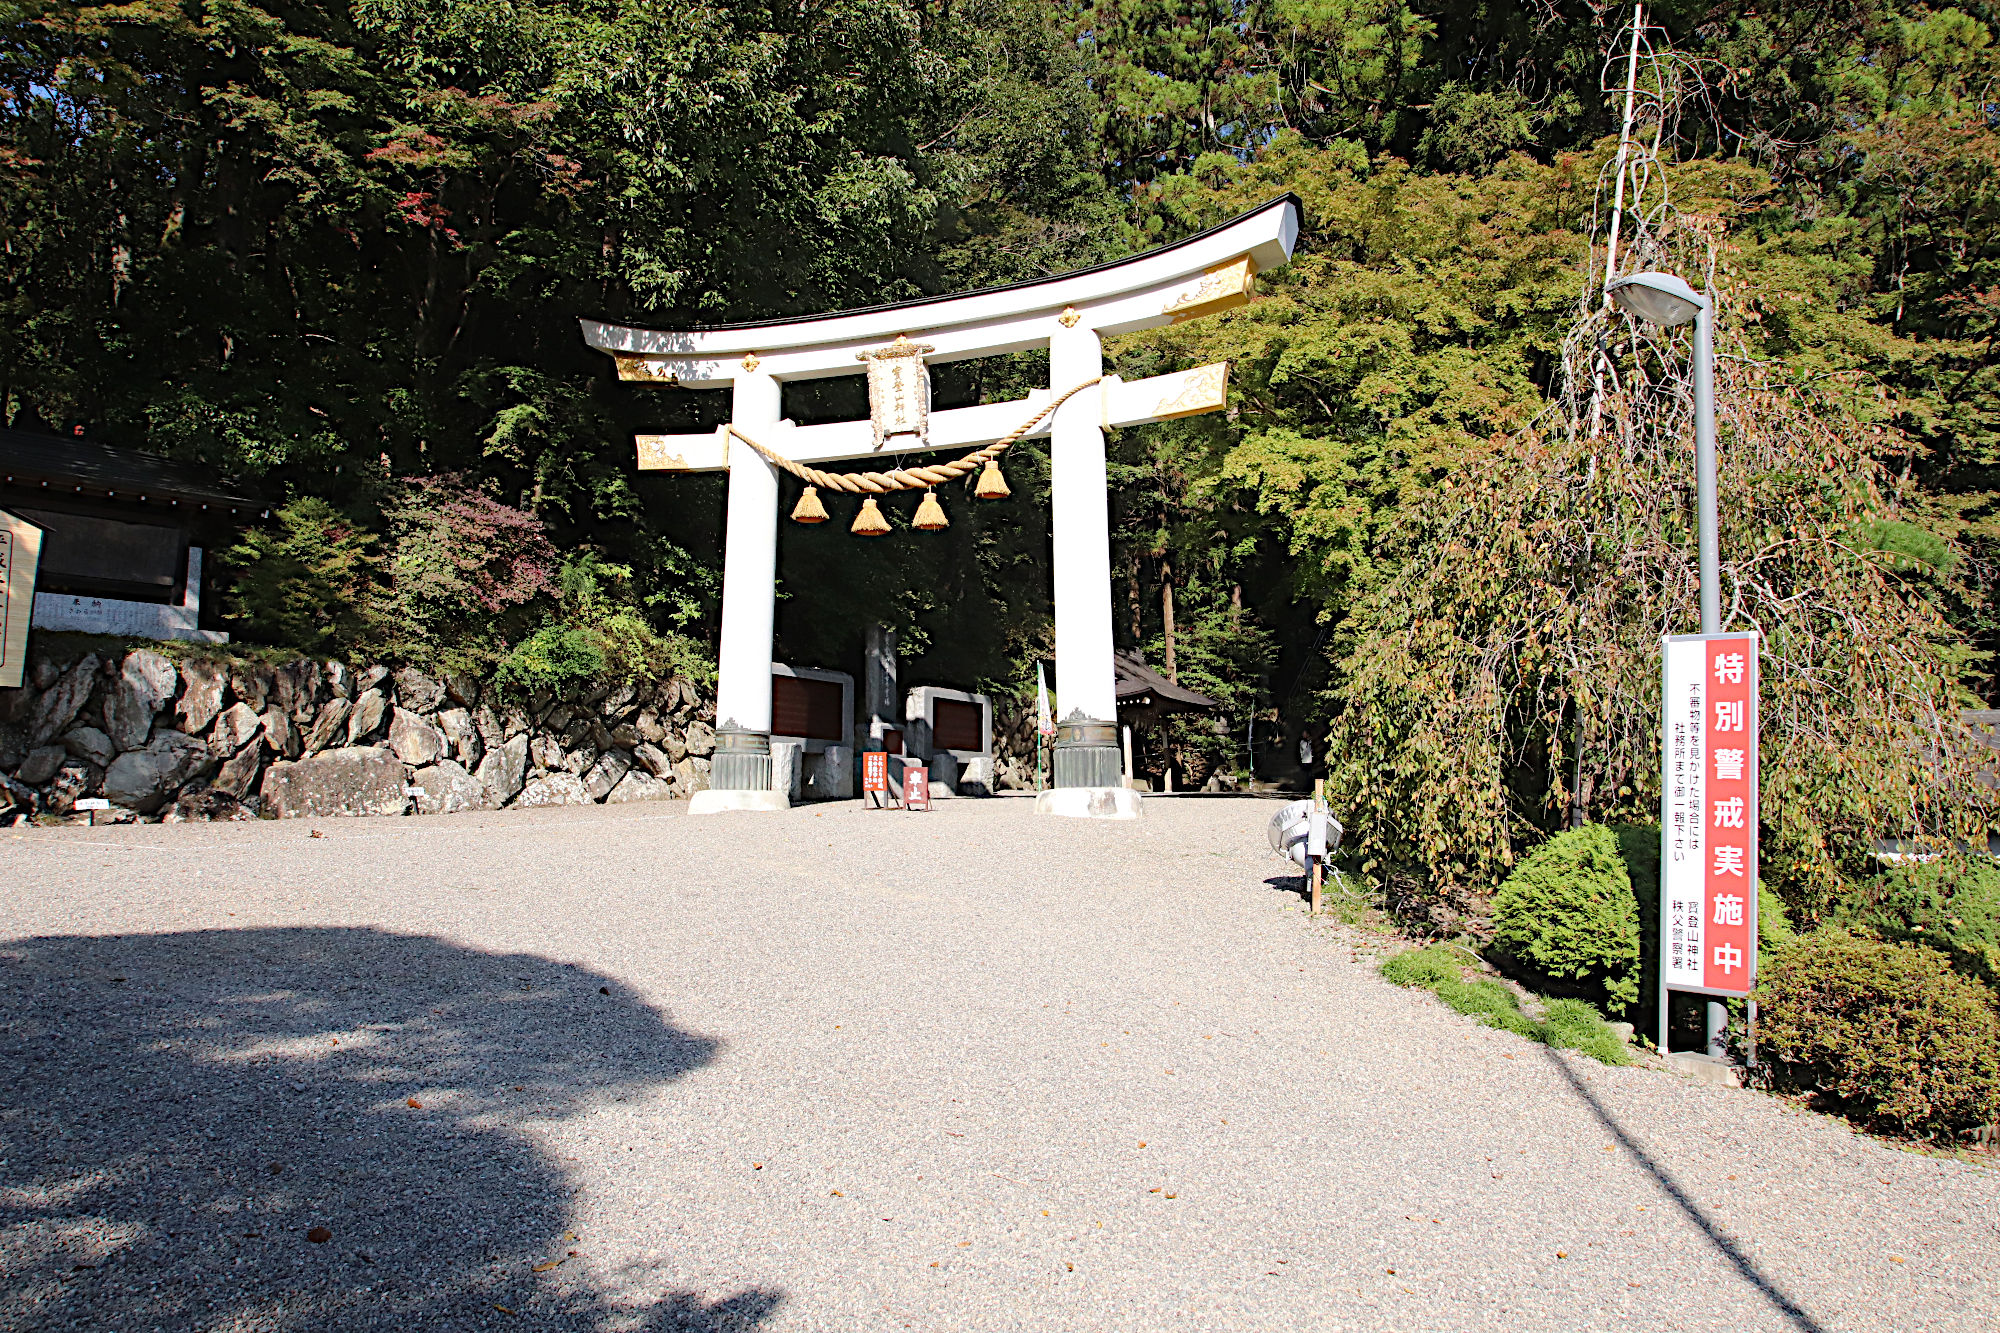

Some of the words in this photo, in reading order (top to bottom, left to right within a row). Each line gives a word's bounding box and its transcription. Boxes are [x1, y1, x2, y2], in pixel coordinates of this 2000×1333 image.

[1674, 722, 1686, 861] 社務所まで御一報下さい
[1689, 683, 1701, 850] 不審物等を見かけた場合には
[1713, 652, 1744, 975] 特別警戒実施中
[1672, 900, 1684, 970] 秩父警察署
